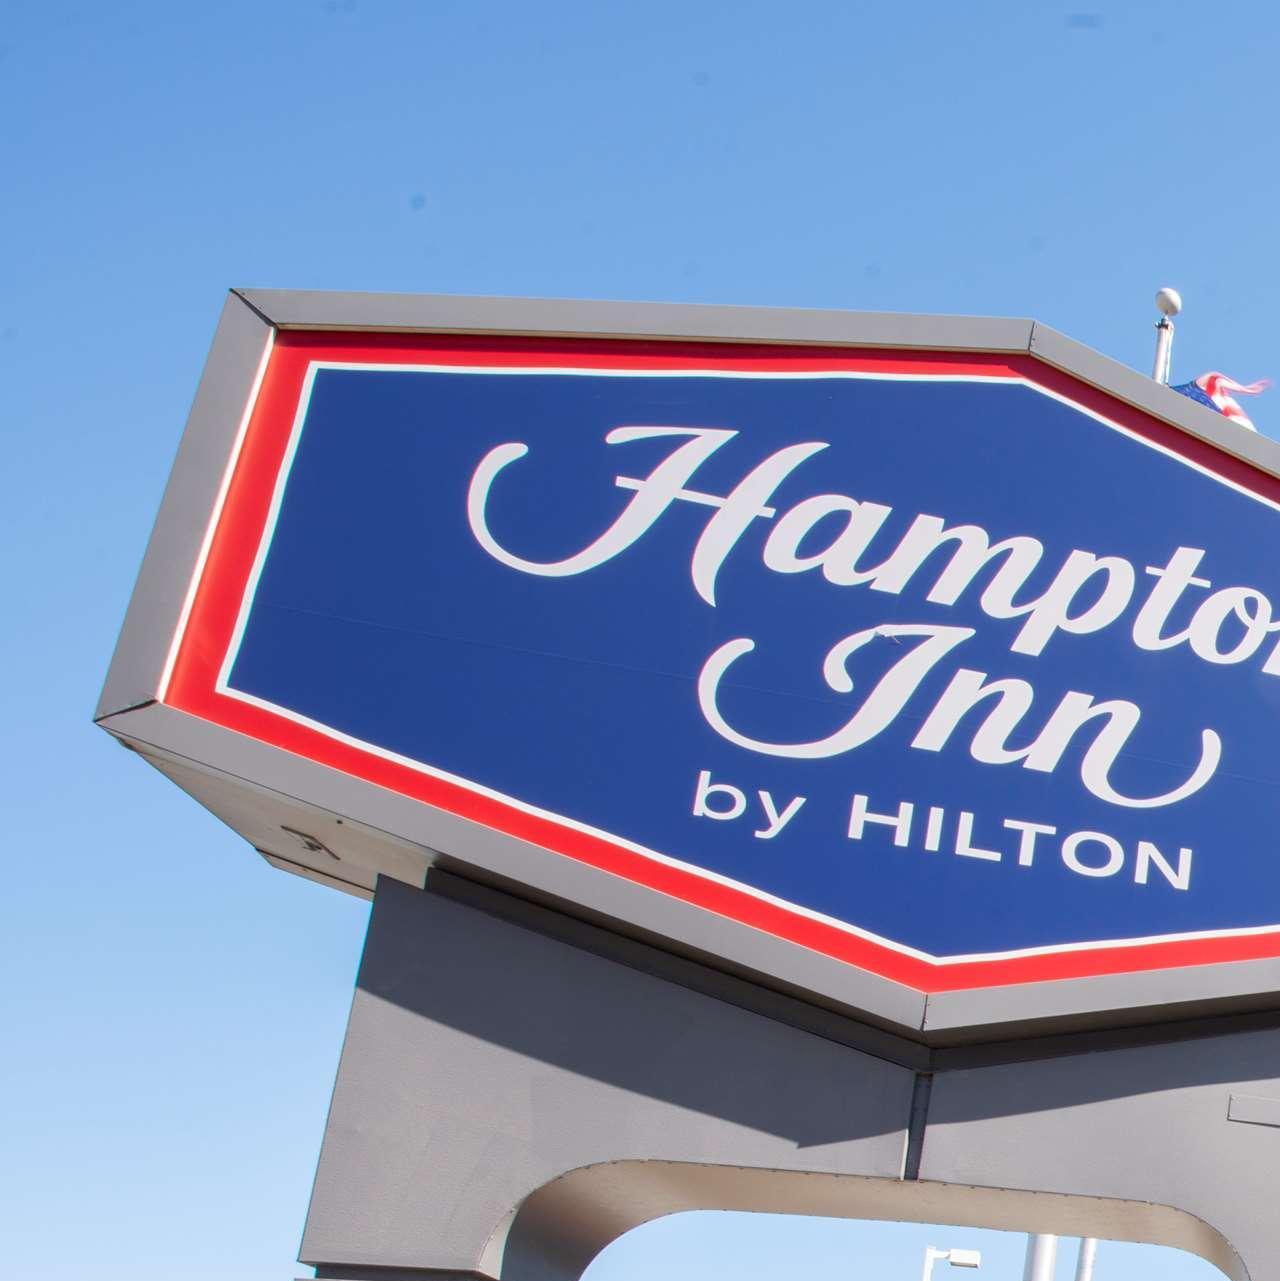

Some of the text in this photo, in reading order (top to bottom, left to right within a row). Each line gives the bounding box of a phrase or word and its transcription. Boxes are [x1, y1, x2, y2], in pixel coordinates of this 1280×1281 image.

[697, 623, 1222, 809] Inn
[692, 770, 1193, 891] by HILTON
